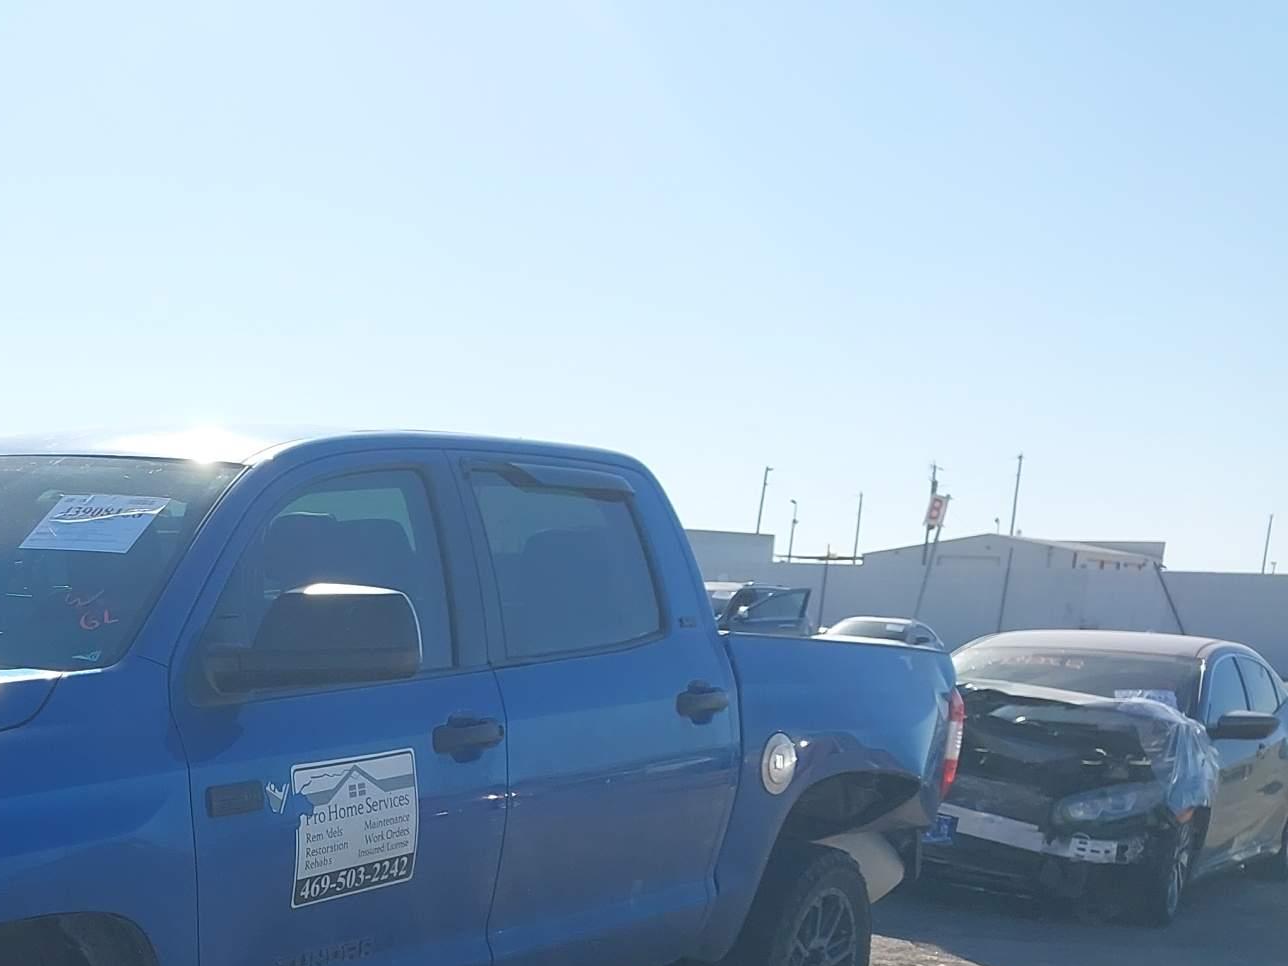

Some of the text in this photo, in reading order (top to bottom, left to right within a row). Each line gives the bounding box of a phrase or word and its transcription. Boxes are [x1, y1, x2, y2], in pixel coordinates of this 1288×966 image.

[927, 497, 943, 520] B
[328, 803, 364, 822] Home
[365, 792, 410, 814] Services
[363, 814, 410, 831] Maintenance
[305, 827, 343, 844] Remdels
[364, 827, 410, 845] Work Orders
[305, 841, 349, 858] Restoration
[304, 857, 333, 871] Rehabs
[300, 856, 408, 899] 469-503-2242
